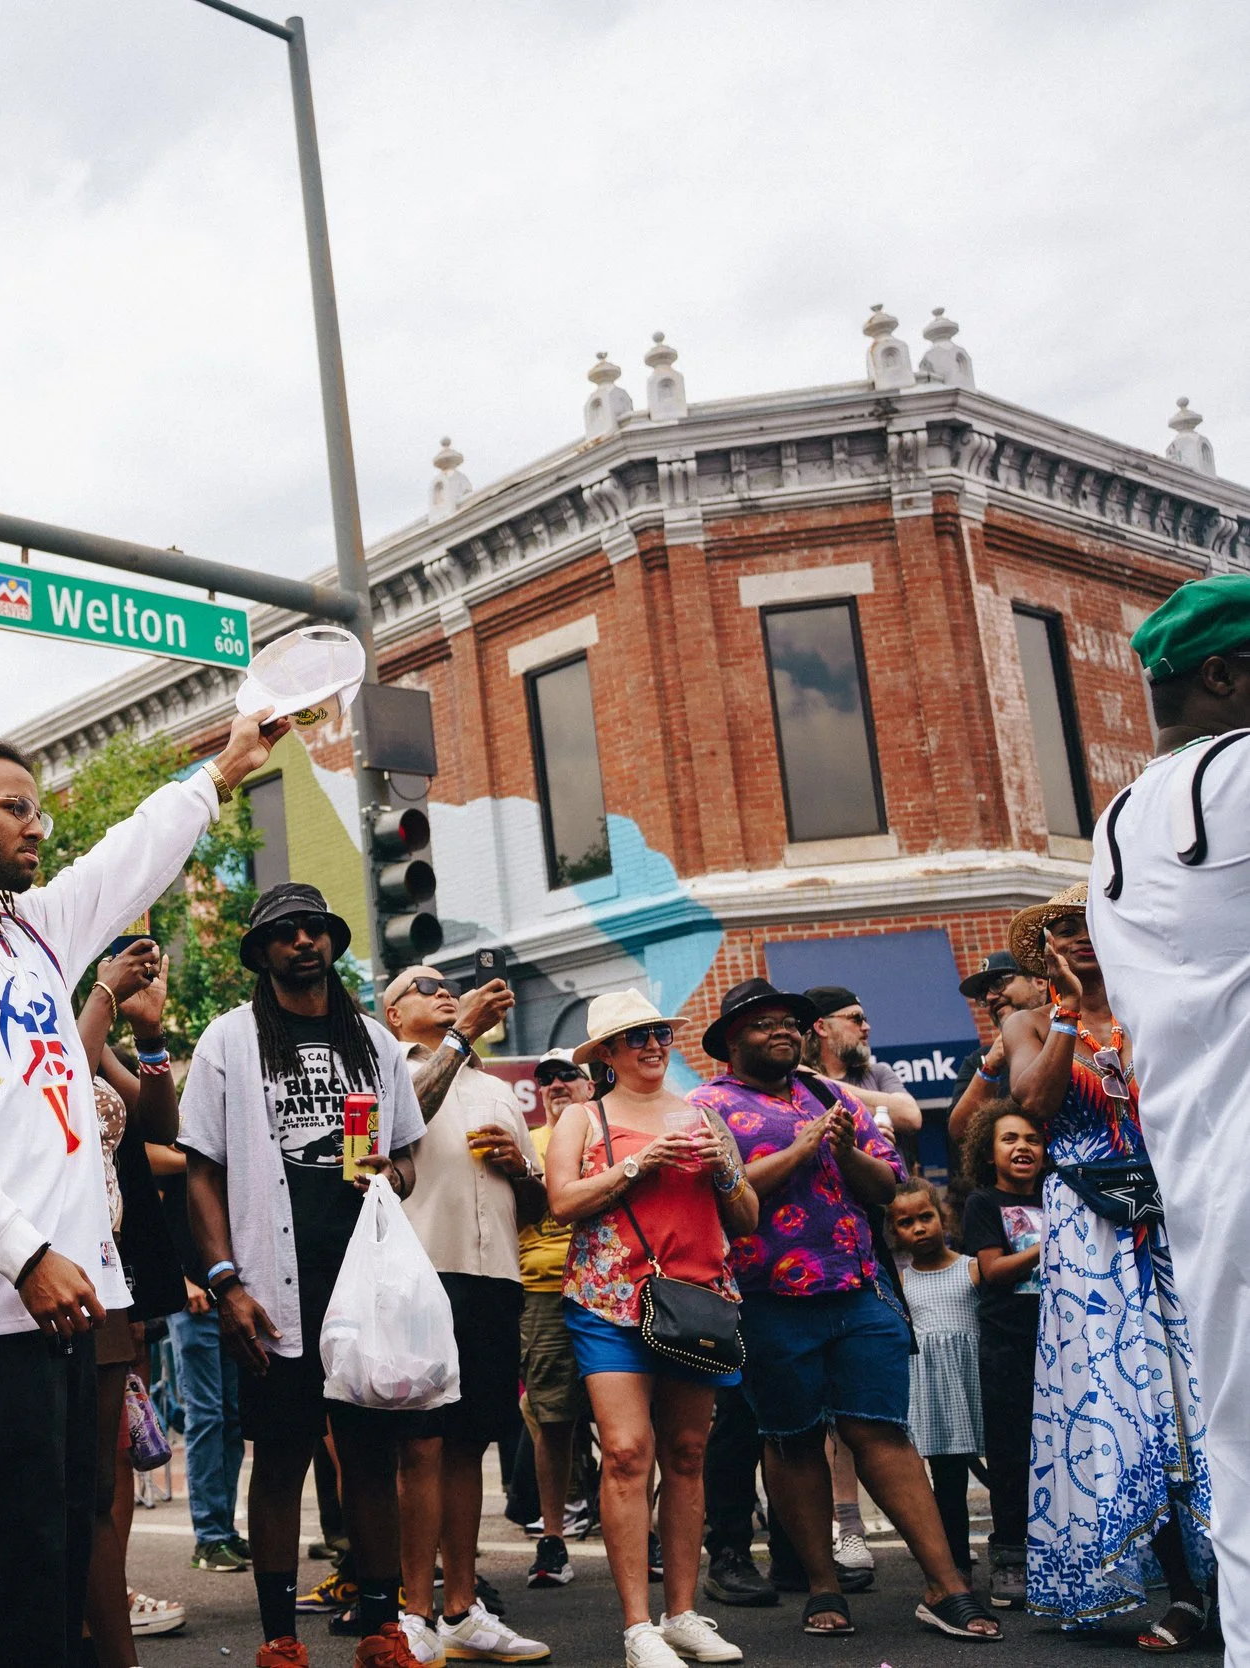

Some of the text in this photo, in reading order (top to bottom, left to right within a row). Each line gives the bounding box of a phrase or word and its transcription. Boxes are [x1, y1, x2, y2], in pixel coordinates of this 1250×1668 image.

[47, 583, 187, 648] Welton
[220, 616, 236, 635] St
[214, 634, 245, 656] 600
[283, 1117, 294, 1125] ALL
